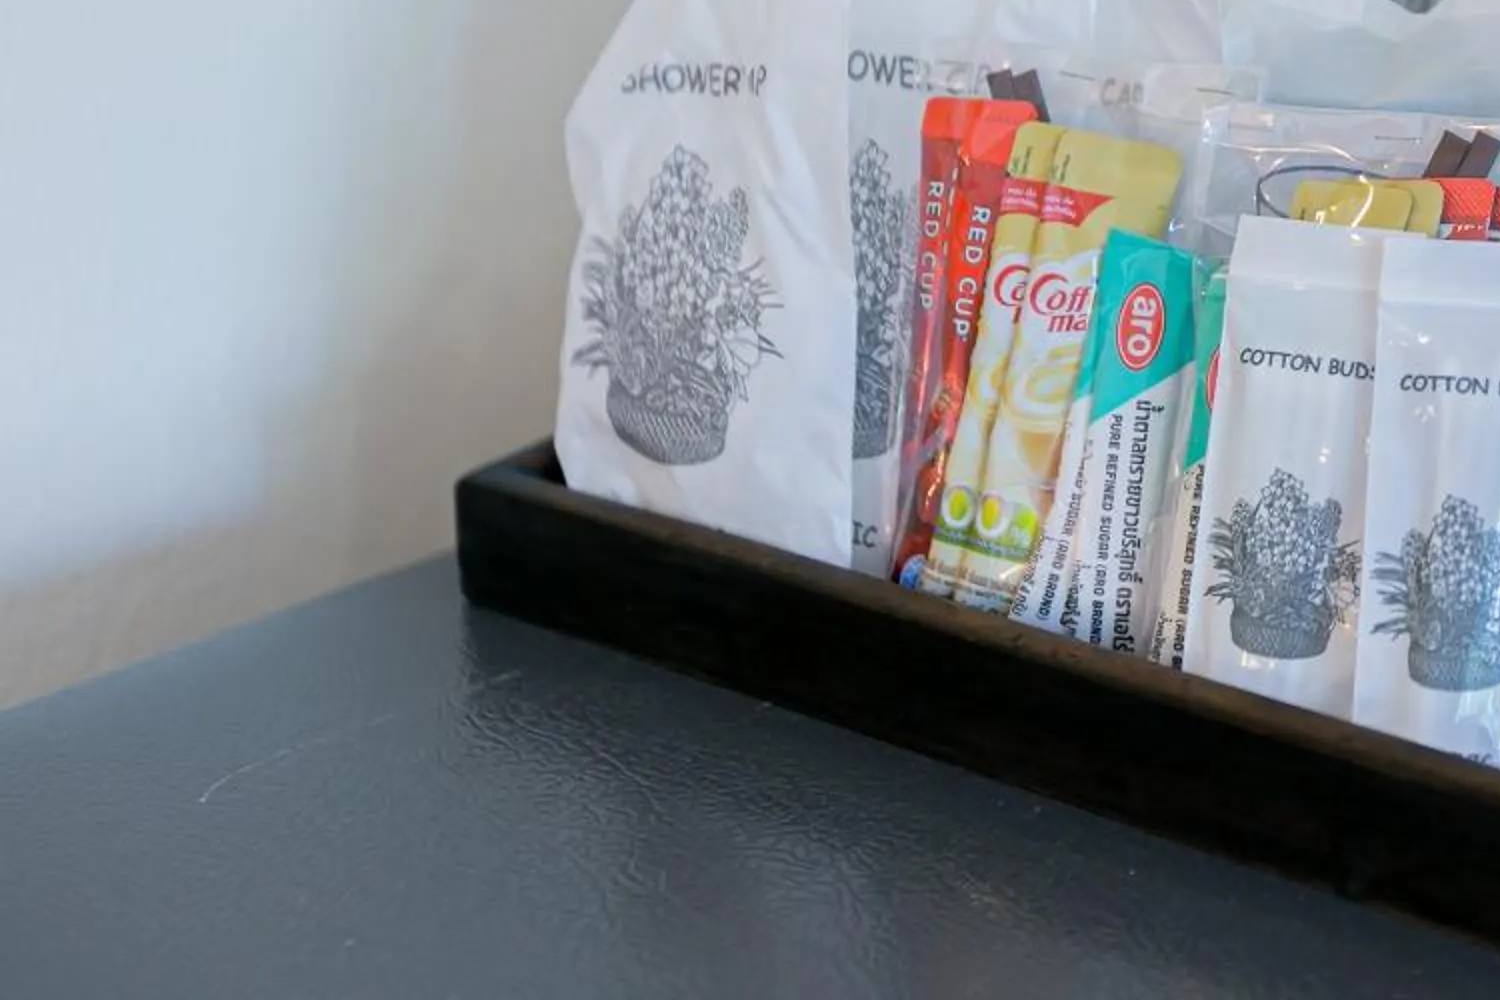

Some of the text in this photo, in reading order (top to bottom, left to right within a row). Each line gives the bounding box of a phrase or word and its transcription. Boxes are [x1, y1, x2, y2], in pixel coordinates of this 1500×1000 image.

[919, 181, 945, 310] RED CUP
[953, 205, 991, 337] RED CUP
[1128, 295, 1158, 357] aro
[1239, 347, 1322, 374] COTTON
[1399, 373, 1490, 396] COTTON
[1108, 413, 1123, 449] PURE
[1101, 454, 1119, 512] REFINED
[1097, 516, 1113, 562] SUGAR
